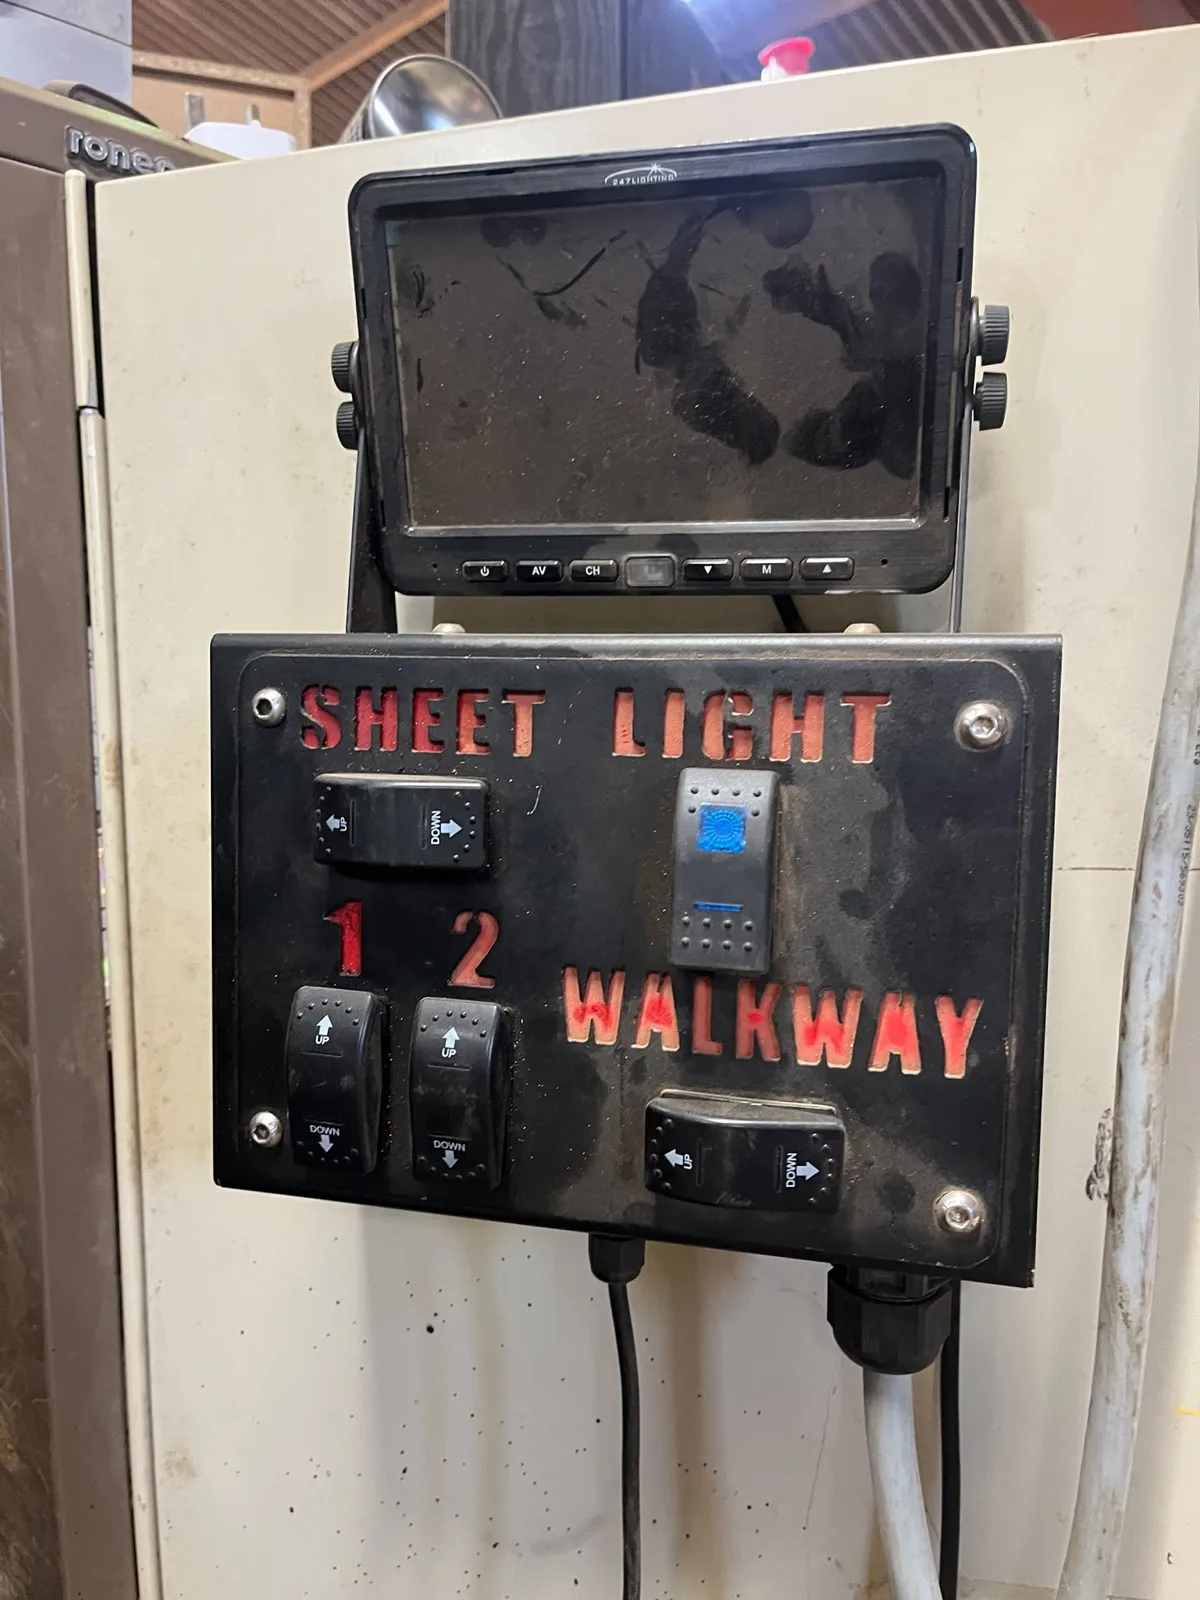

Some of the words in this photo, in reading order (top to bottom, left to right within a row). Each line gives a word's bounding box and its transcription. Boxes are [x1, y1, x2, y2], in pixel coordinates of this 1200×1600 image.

[532, 566, 546, 575] AV
[585, 566, 600, 576] CH
[762, 564, 771, 574] M
[301, 684, 546, 757] SHEET
[612, 687, 892, 763] LIGHT
[340, 817, 347, 832] UP
[431, 810, 441, 845] DOWN
[323, 901, 363, 976] 1
[448, 911, 499, 988] 2
[563, 966, 984, 1079] WALKWAY
[315, 1035, 329, 1045] UP
[441, 1048, 457, 1058] UP
[310, 1124, 340, 1136] DOWN
[434, 1140, 466, 1152] DOWN
[683, 1154, 692, 1170] UP
[786, 1152, 796, 1188] DOWN
